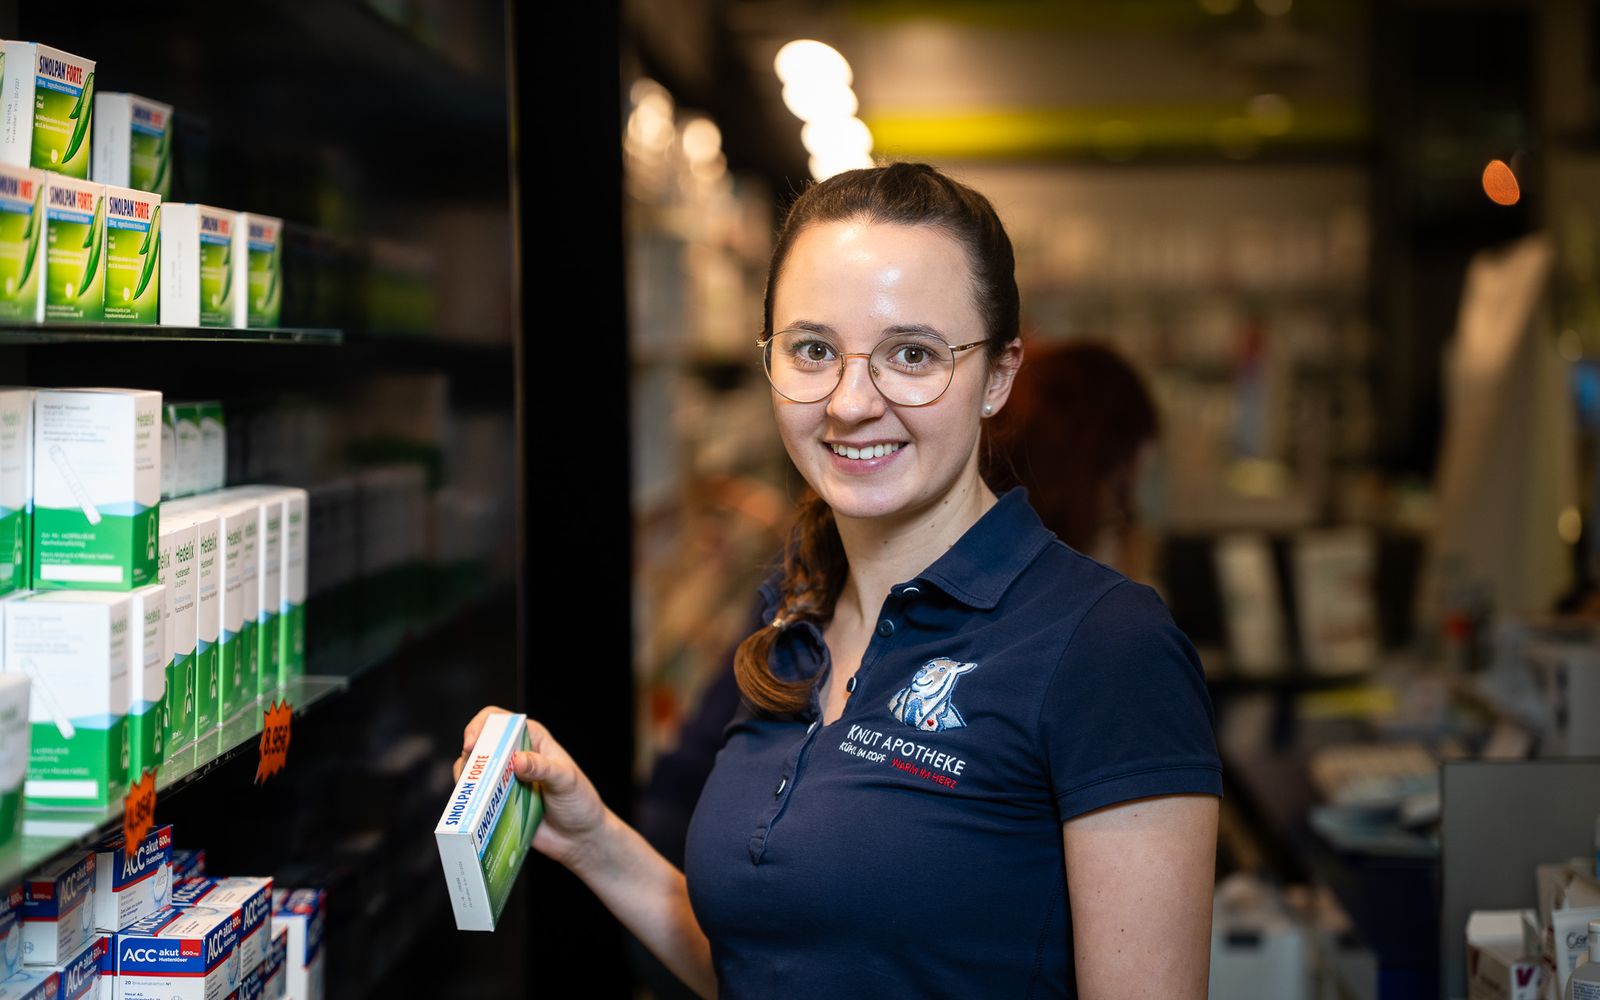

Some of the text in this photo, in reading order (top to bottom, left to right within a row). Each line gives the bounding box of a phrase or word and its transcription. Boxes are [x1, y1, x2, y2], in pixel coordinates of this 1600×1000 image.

[39, 55, 83, 85] SINOLPAN FORTE
[49, 186, 93, 212] SINOLPAN FORTE
[109, 197, 150, 220] SINOLPAN FORTE
[175, 538, 196, 565] Hedelix
[200, 529, 217, 556] Hedelix
[847, 725, 966, 776] KNUT APOTHEKE
[856, 747, 868, 758] IM
[865, 751, 888, 764] KOPF
[891, 758, 918, 775] WARM
[919, 767, 932, 781] IM
[932, 773, 958, 789] HERZ
[446, 754, 490, 826] SINOLPAN FORTE
[477, 781, 504, 845] SINOLPAN
[122, 846, 146, 880] ACC
[146, 838, 159, 857] akut
[60, 873, 77, 909] ACC
[122, 947, 158, 963] ACC
[158, 948, 179, 957] akut
[207, 929, 224, 965] ACC
[222, 921, 233, 938] akut
[66, 961, 84, 998] ACC
